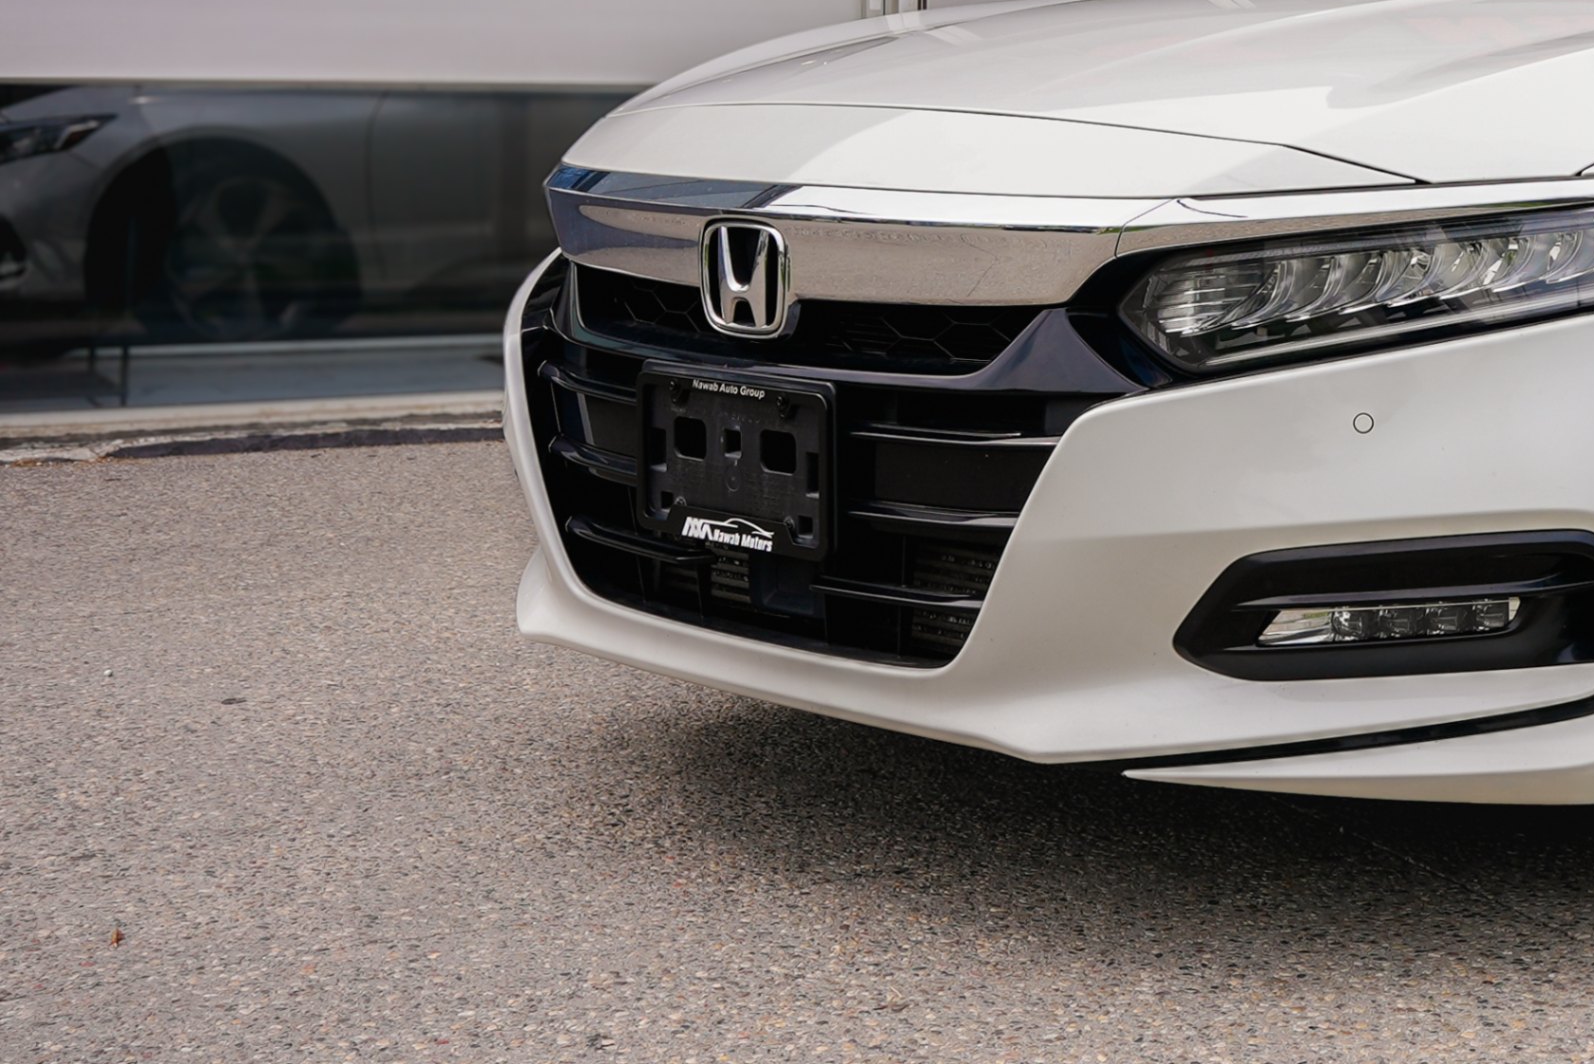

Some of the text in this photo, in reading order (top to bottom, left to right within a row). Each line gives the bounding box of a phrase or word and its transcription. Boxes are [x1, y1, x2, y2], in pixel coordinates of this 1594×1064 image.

[692, 379, 766, 400] Nawab Auto Group
[713, 528, 740, 546] Nawab
[741, 534, 773, 552] Motors
